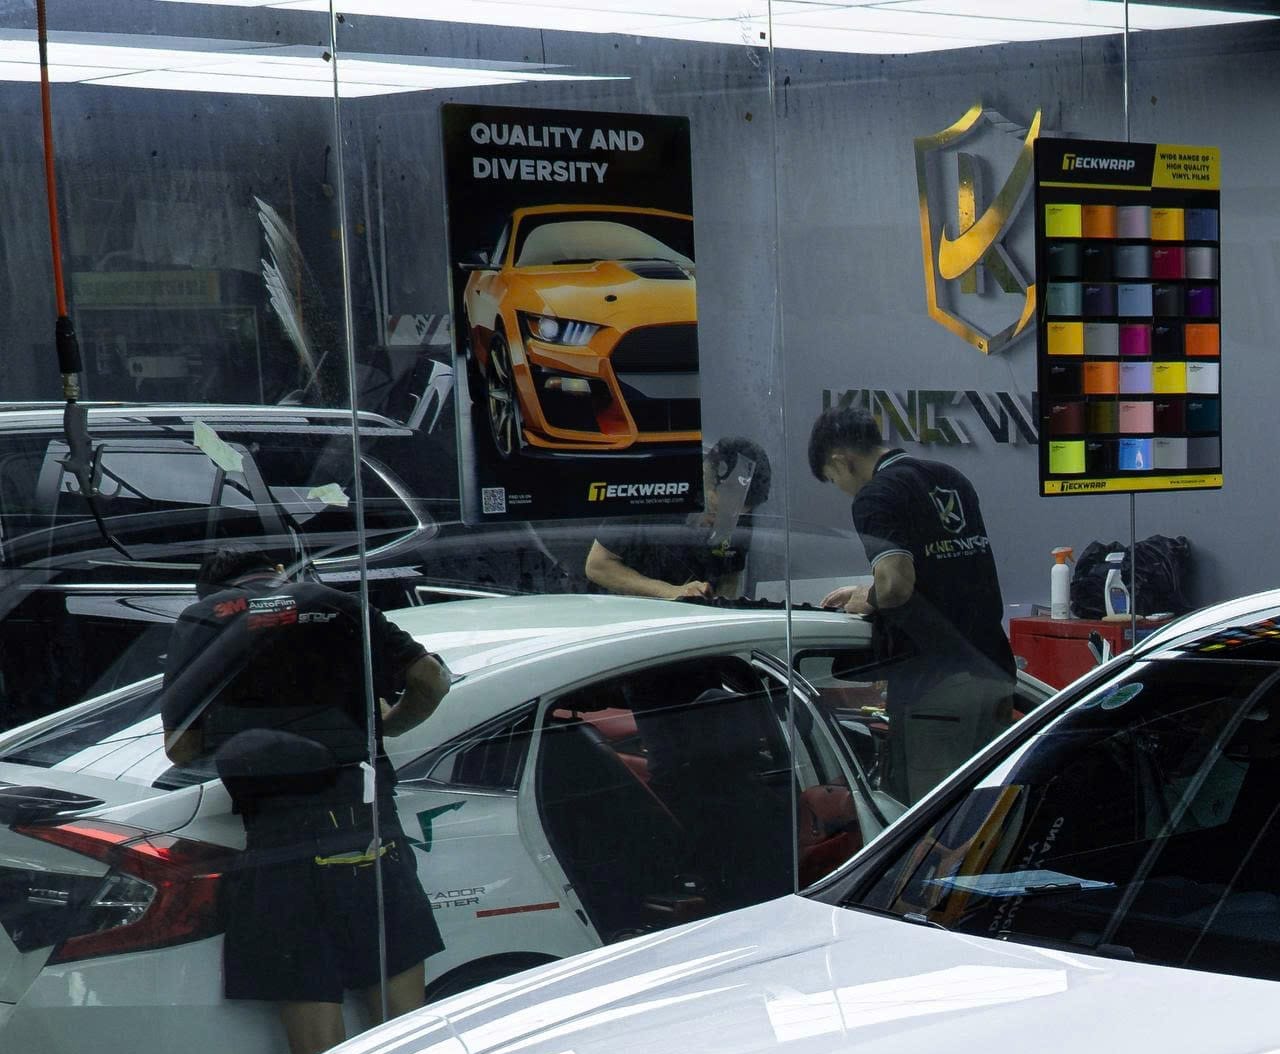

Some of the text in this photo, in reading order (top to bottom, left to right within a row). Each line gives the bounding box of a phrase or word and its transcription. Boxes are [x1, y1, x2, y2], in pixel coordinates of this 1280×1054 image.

[470, 122, 644, 152] QUALITY AND
[473, 157, 608, 184] DIVERSITY
[1062, 154, 1135, 171] TECKWRAP
[588, 482, 689, 501] TECKWRAP
[1061, 481, 1106, 491] TECKWRAP
[214, 597, 296, 618] 3M AutoFilm
